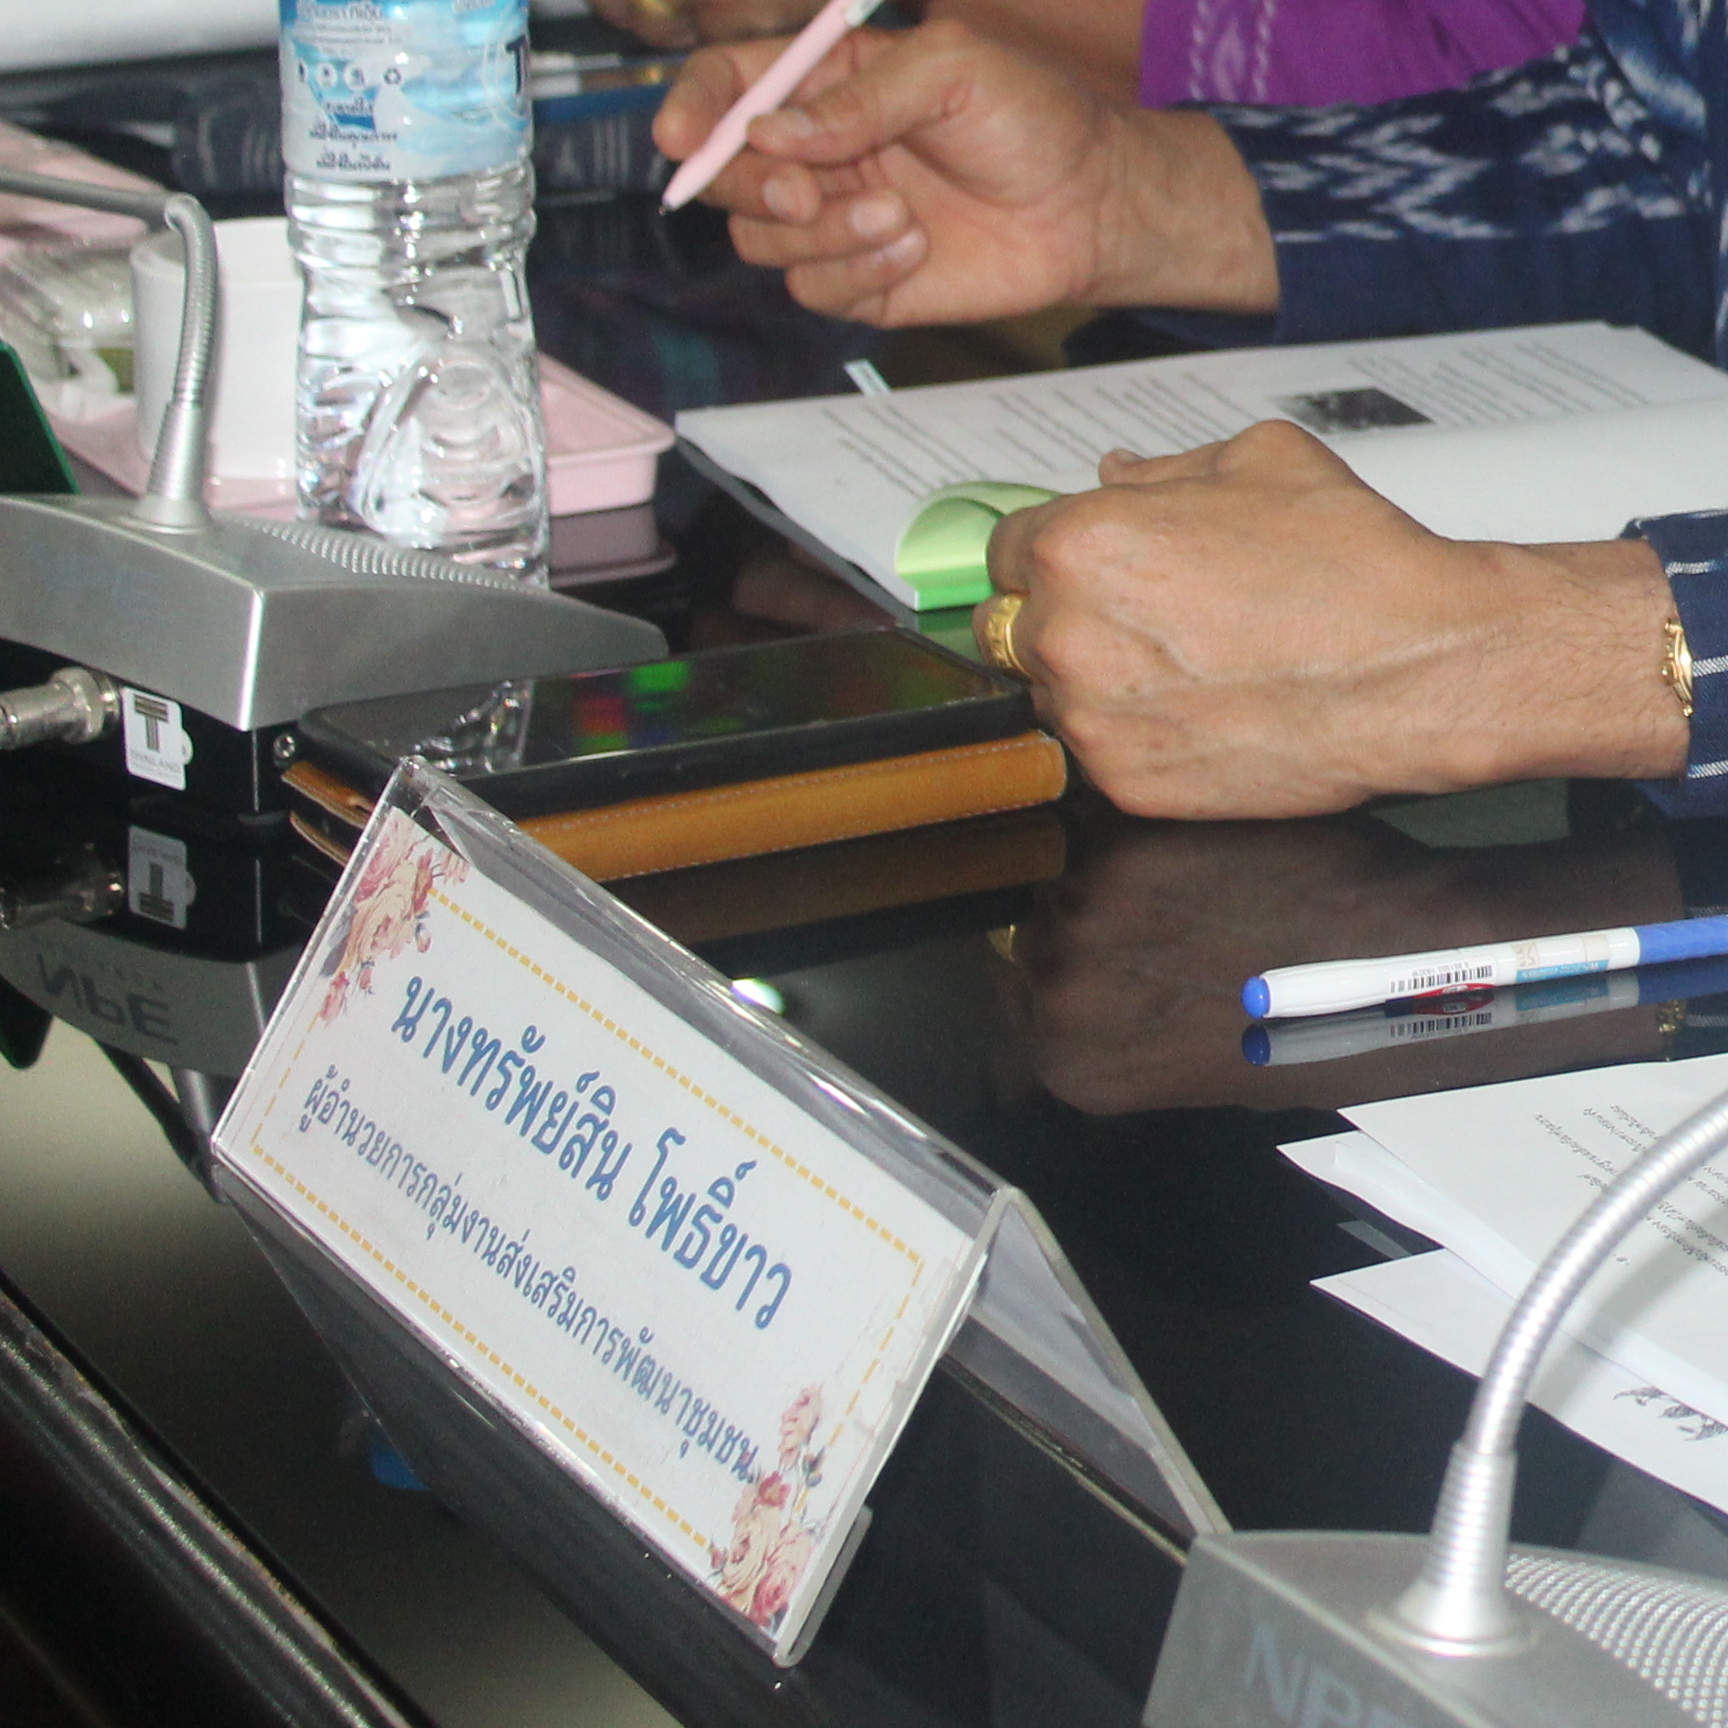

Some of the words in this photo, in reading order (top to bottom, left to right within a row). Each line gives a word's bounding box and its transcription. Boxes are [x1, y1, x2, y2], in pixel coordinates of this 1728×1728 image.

[391, 975, 634, 1202] นางทรัพย์สิน
[628, 1126, 793, 1330] โพธิ์ขาว
[1245, 1622, 1412, 1728] NP
